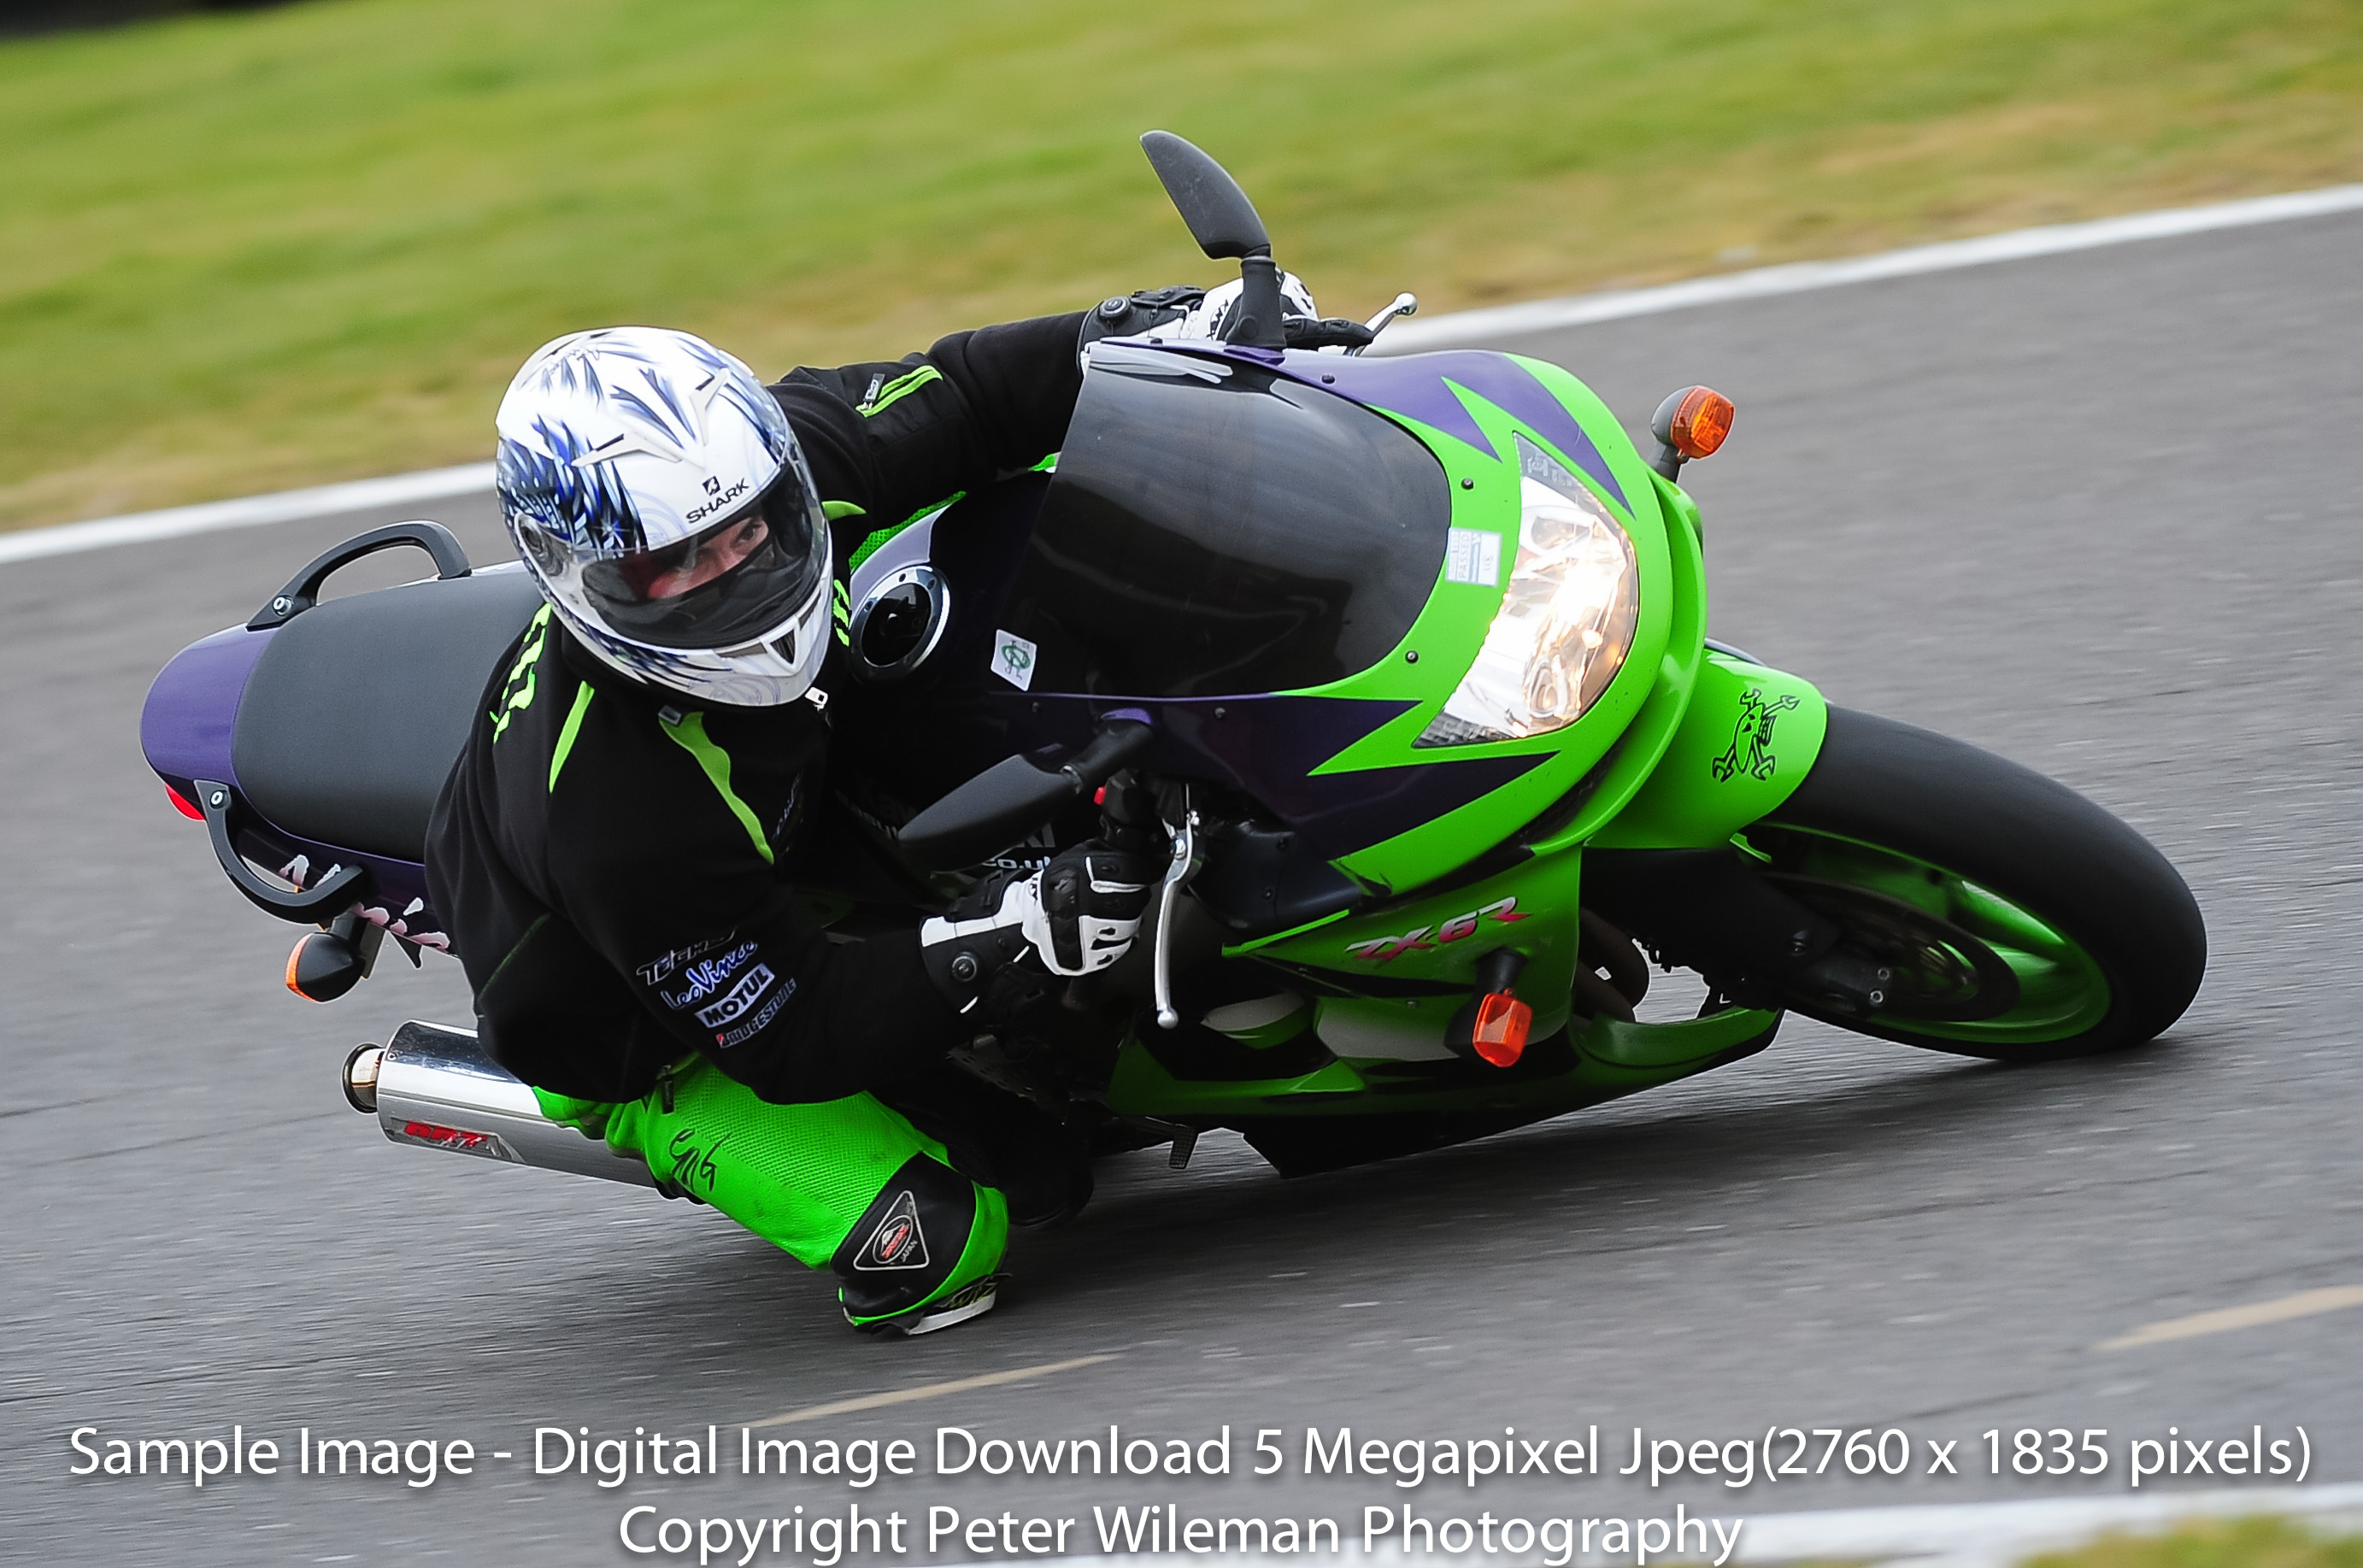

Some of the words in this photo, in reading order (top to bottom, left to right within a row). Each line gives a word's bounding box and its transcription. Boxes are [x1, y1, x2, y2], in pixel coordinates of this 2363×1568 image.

[685, 477, 749, 524] SHARK
[1345, 896, 1532, 963] ZX-6R
[704, 966, 773, 1026] MOTUL
[716, 978, 797, 1049] BRIDGESTONE
